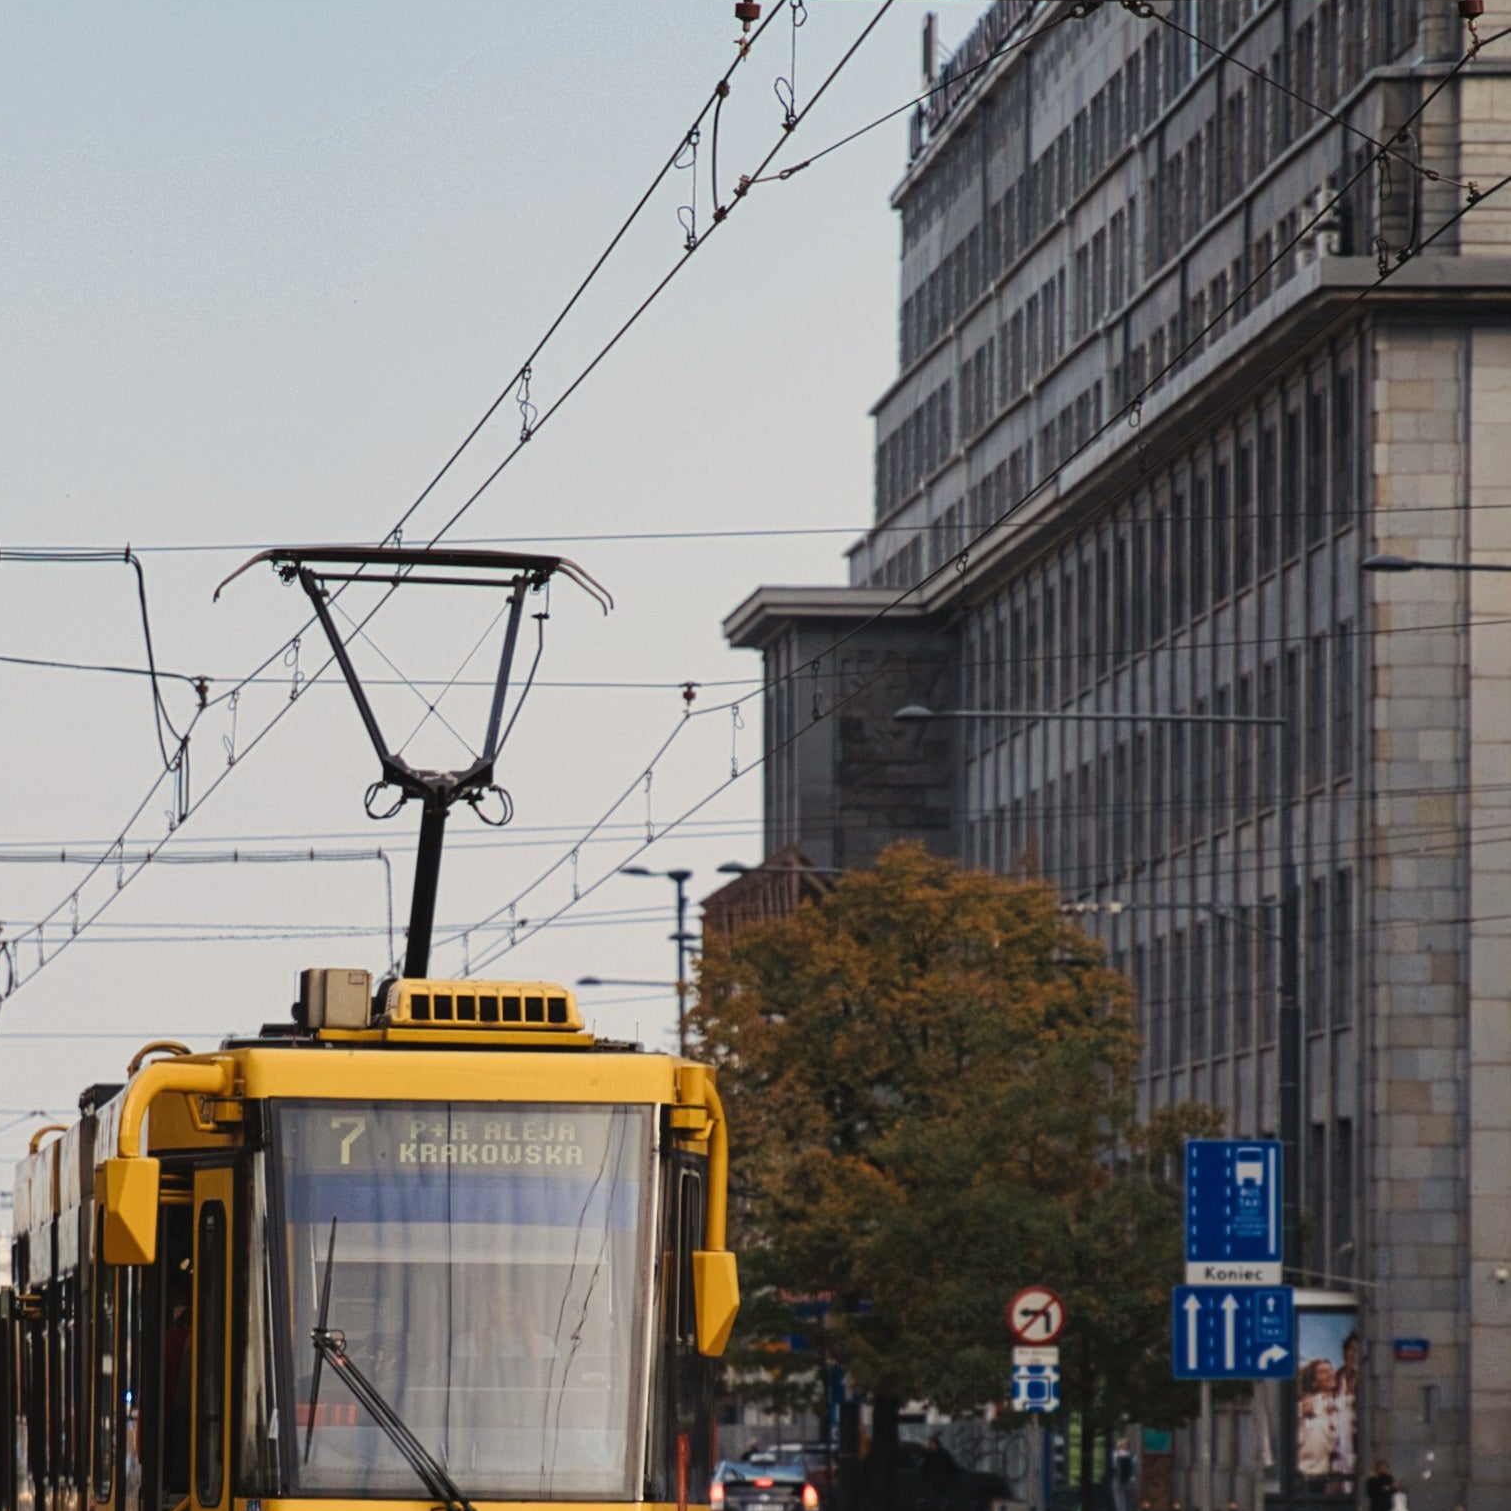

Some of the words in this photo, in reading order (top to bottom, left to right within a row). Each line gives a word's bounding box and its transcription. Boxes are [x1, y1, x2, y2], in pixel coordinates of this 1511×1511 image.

[330, 1116, 367, 1165] 7
[410, 1120, 468, 1143] P+R
[485, 1120, 577, 1143] ALEJA
[400, 1144, 583, 1165] KRAKOWSKA
[1204, 1266, 1264, 1281] Koniec
